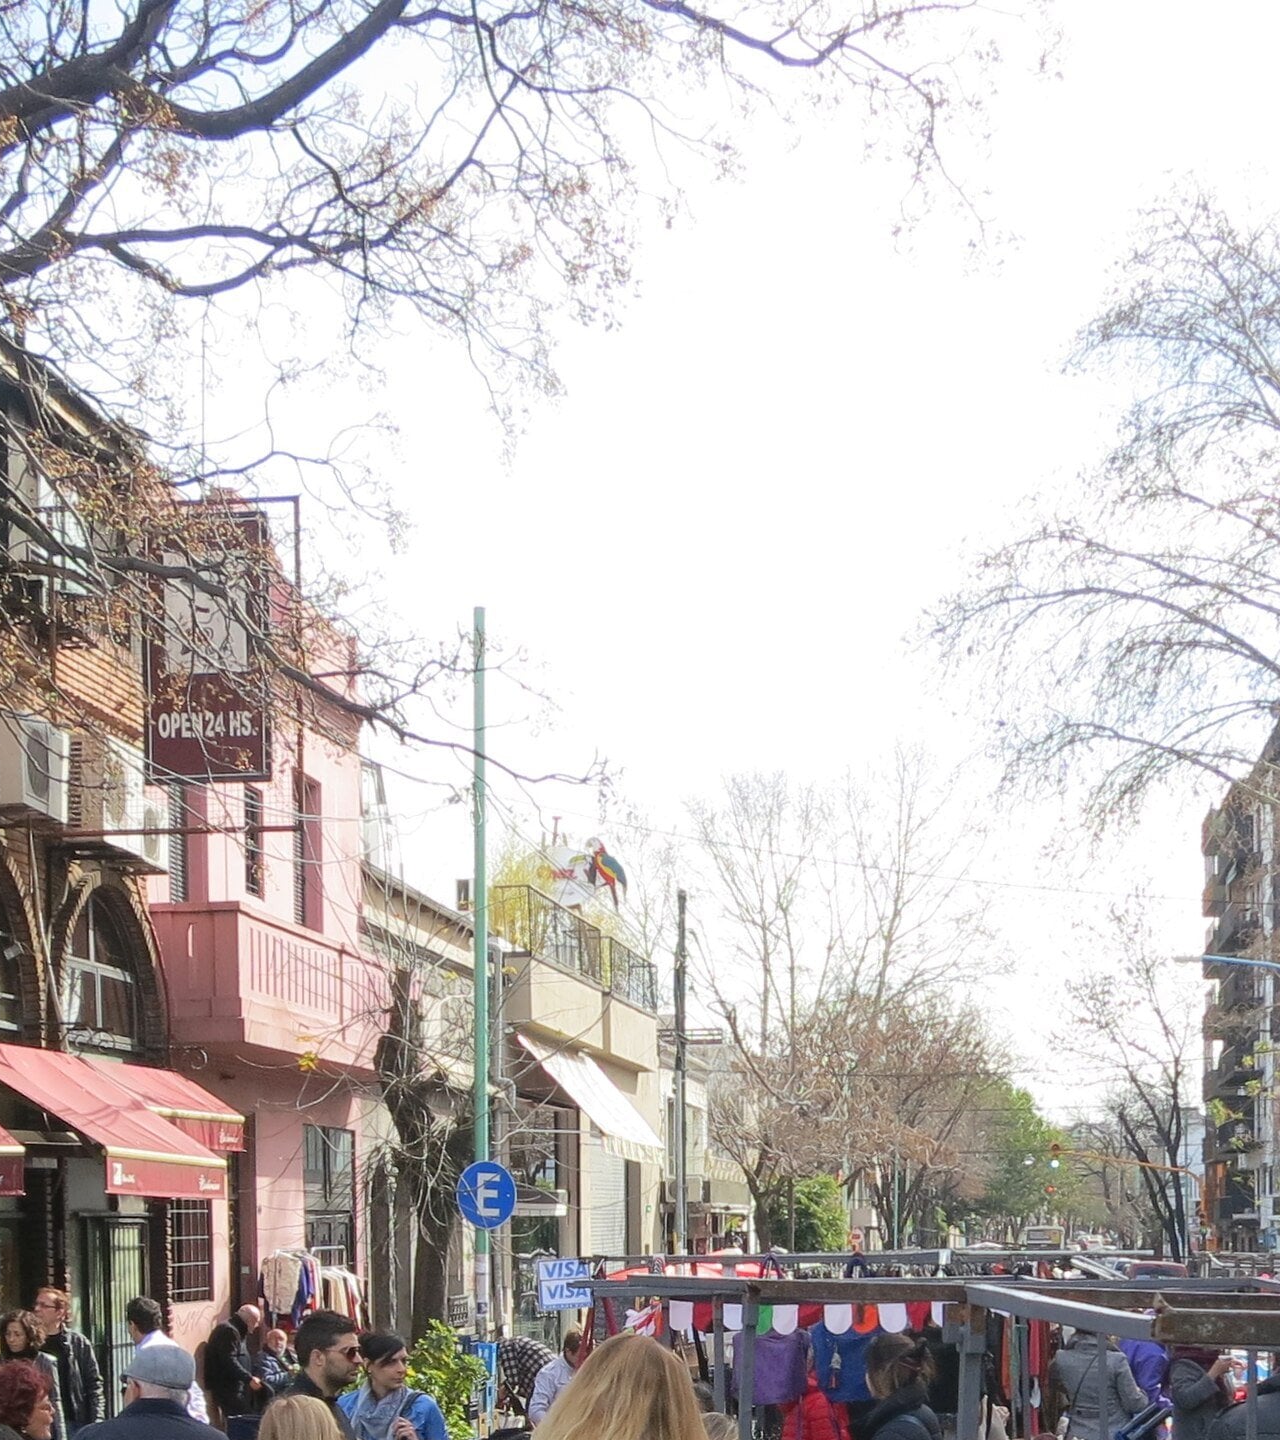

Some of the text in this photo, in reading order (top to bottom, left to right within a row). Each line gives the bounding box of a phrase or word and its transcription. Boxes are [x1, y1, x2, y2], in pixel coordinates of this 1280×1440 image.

[158, 712, 203, 739] OPEN
[204, 711, 226, 738] 24
[476, 1172, 501, 1217] E
[543, 1261, 587, 1279] VISA
